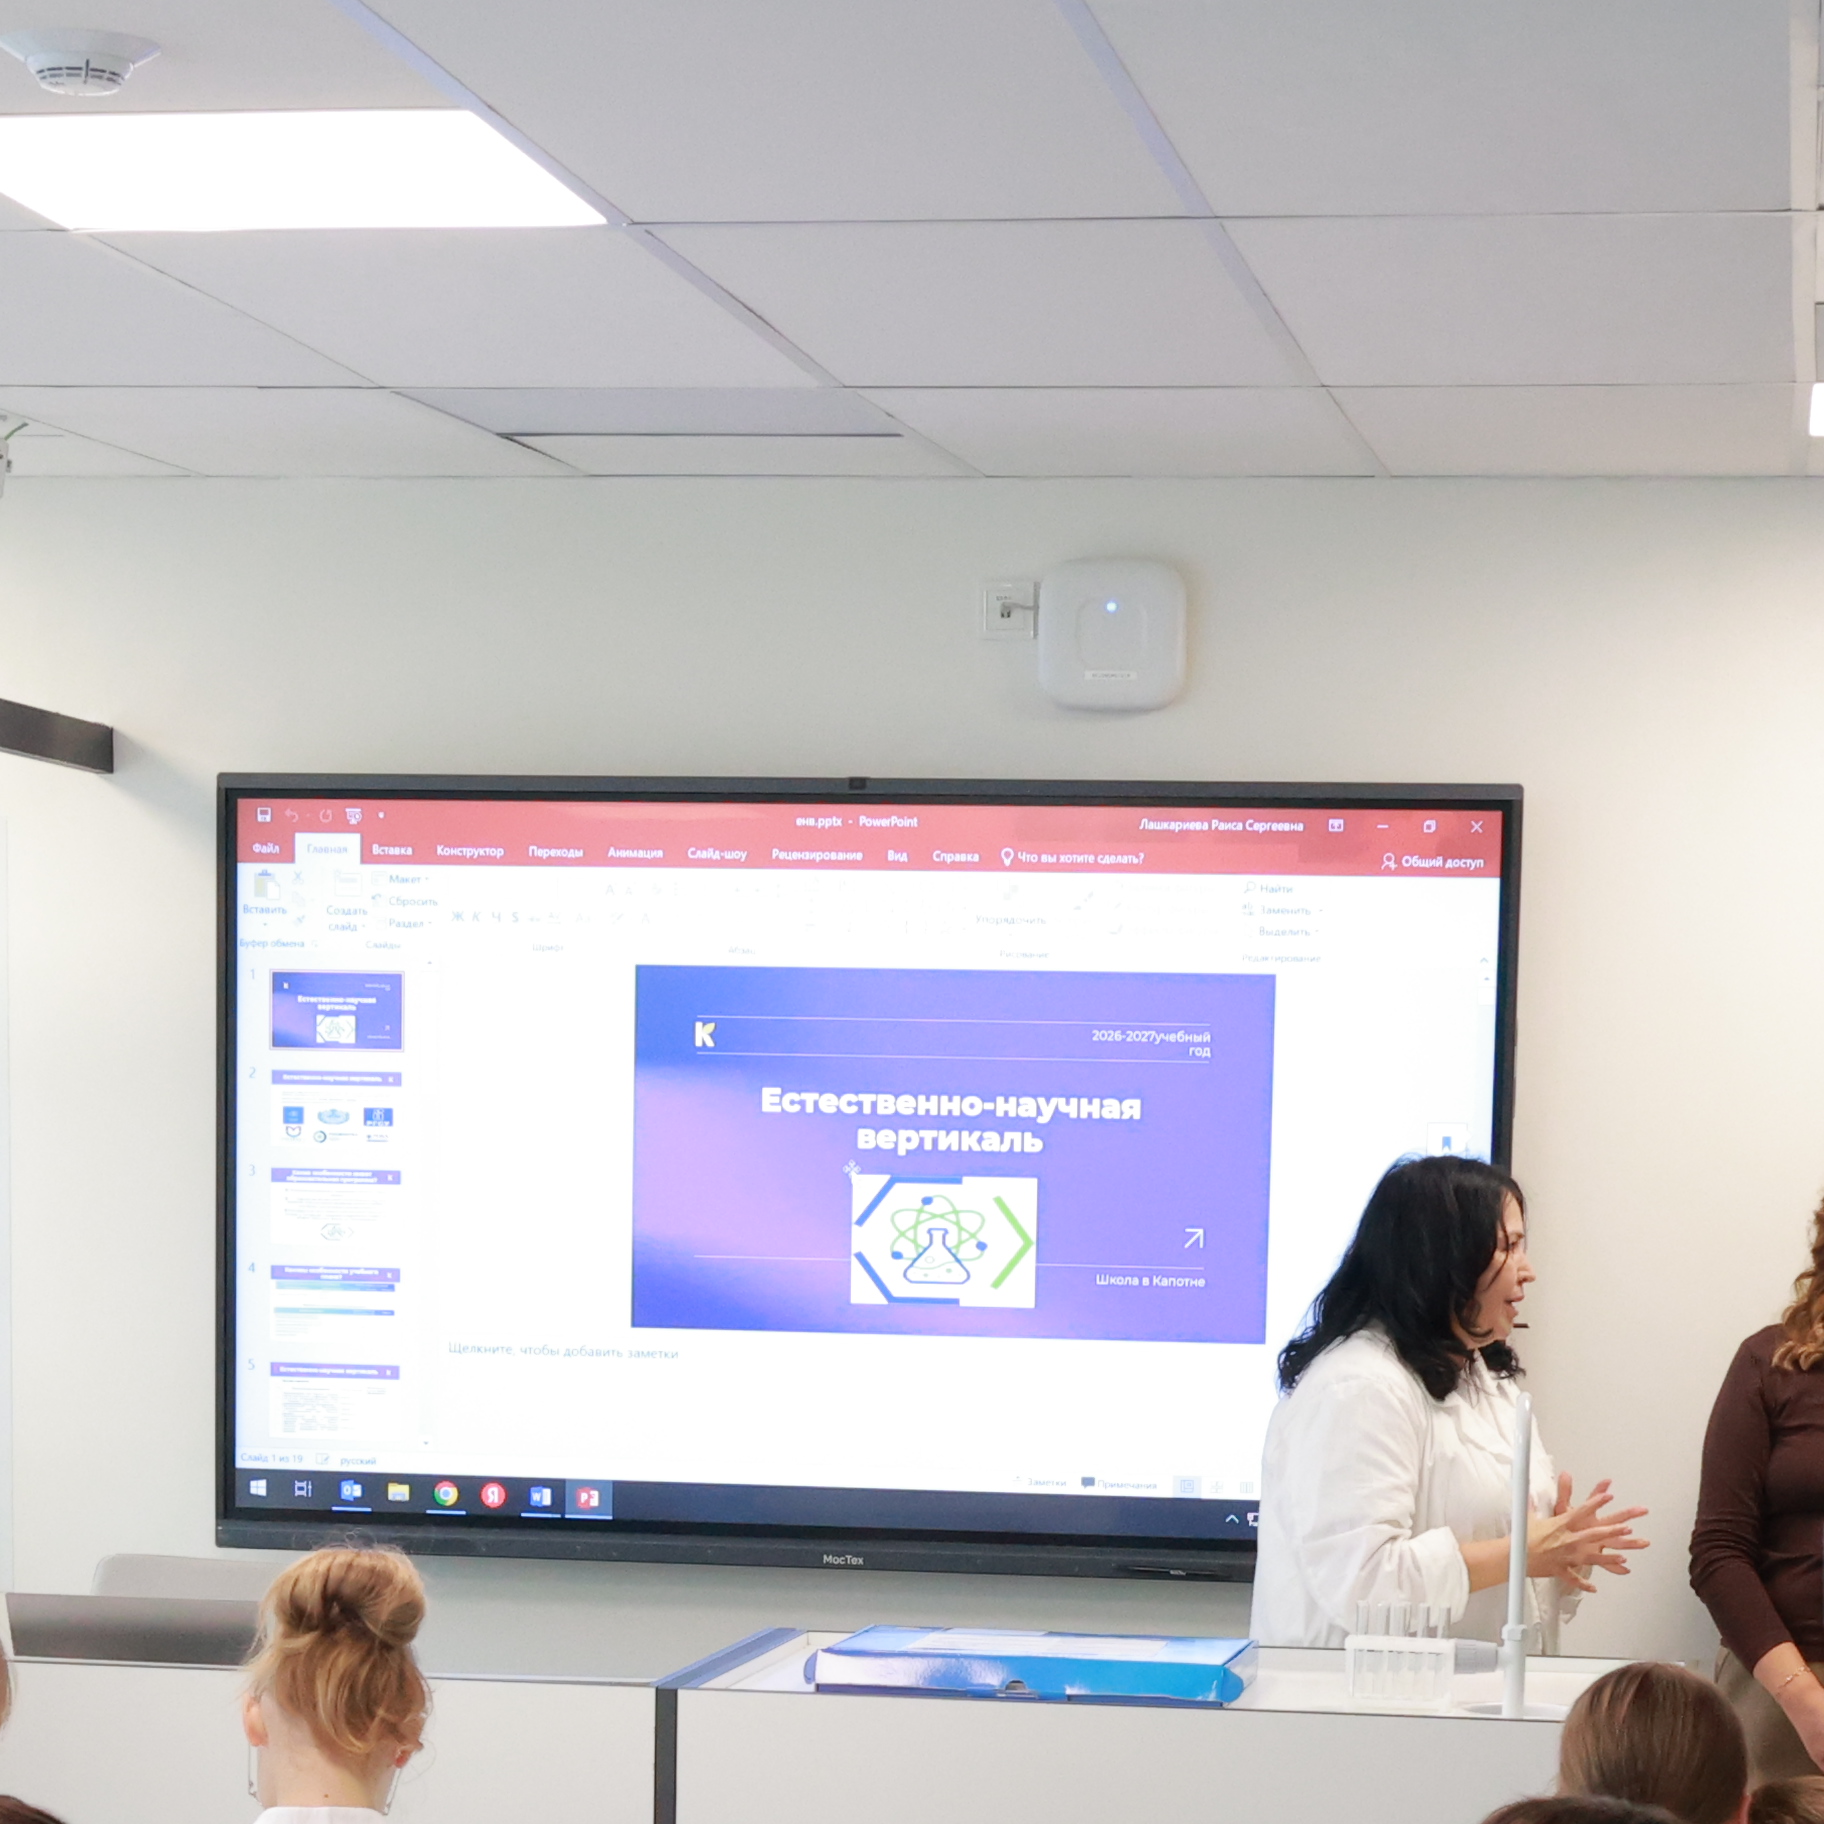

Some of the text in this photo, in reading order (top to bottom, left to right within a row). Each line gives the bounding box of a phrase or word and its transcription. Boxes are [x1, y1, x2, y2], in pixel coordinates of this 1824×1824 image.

[859, 816, 918, 828] PowerPoint
[1139, 817, 1304, 834] Лашкариева Раиса Сергеевна
[253, 843, 279, 855] Файл
[307, 844, 348, 855] Главная
[372, 844, 412, 856] Вставка
[437, 845, 504, 858] Конструктор
[529, 845, 584, 859] Переходы
[608, 847, 663, 859] Анимация
[688, 847, 747, 862] Слайд-шоу
[772, 849, 863, 862] Рецензирование
[887, 851, 908, 863] Вид
[933, 851, 980, 863] Справка
[1018, 852, 1144, 865] Что вы хотите сделать?
[1402, 856, 1484, 870] Общий доступ
[389, 874, 421, 884] Макет
[1260, 883, 1293, 894] Найти
[243, 904, 287, 915] Вставить
[327, 905, 368, 917] Создать
[240, 938, 305, 949] Буфер обмена
[251, 969, 255, 980] 1
[1092, 1030, 1211, 1045] 2026-2027учебный
[1189, 1045, 1211, 1058] год
[249, 1067, 256, 1078] 2
[761, 1087, 1142, 1123] Естественно-научная
[857, 1128, 1044, 1157] вертикаль
[249, 1165, 255, 1176] 3
[248, 1262, 255, 1273] 4
[1096, 1274, 1205, 1287] Школа в Капотне
[520, 1344, 559, 1356] чтобы
[564, 1345, 622, 1358] добавить
[628, 1350, 678, 1359] заметки
[248, 1359, 255, 1370] 5
[241, 1453, 268, 1462] Слайд
[293, 1455, 303, 1463] 19
[340, 1457, 376, 1466] русский
[823, 1554, 864, 1565] МосТех
